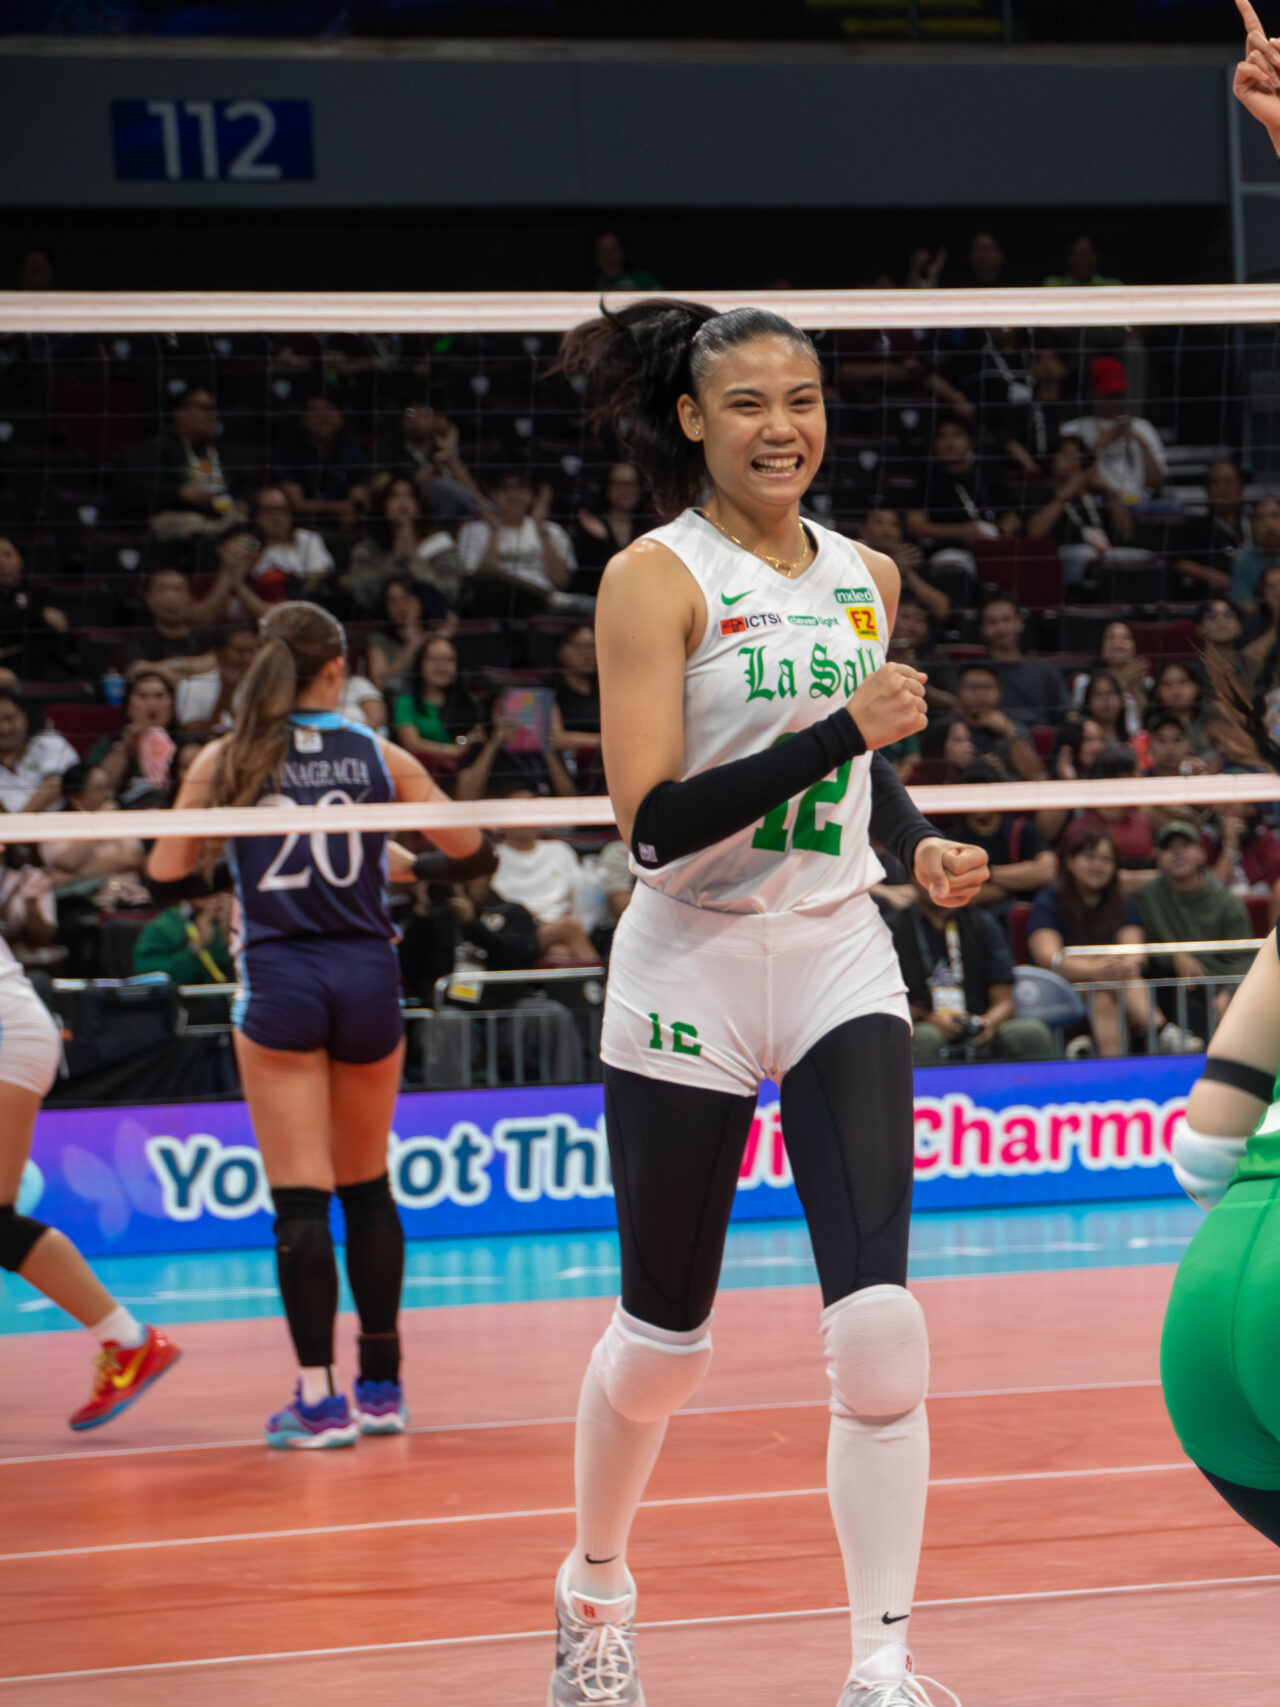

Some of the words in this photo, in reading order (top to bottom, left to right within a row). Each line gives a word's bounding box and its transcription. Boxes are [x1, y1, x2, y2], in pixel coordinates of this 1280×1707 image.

[148, 101, 282, 180] 112
[836, 588, 873, 603] nxled
[744, 613, 782, 629] ICTSI
[818, 616, 841, 628] light
[851, 611, 875, 631] F2
[738, 645, 798, 704] La
[809, 642, 877, 699] Sall
[256, 789, 364, 892] 20
[150, 1141, 263, 1211] Yo
[396, 1129, 485, 1199] ot
